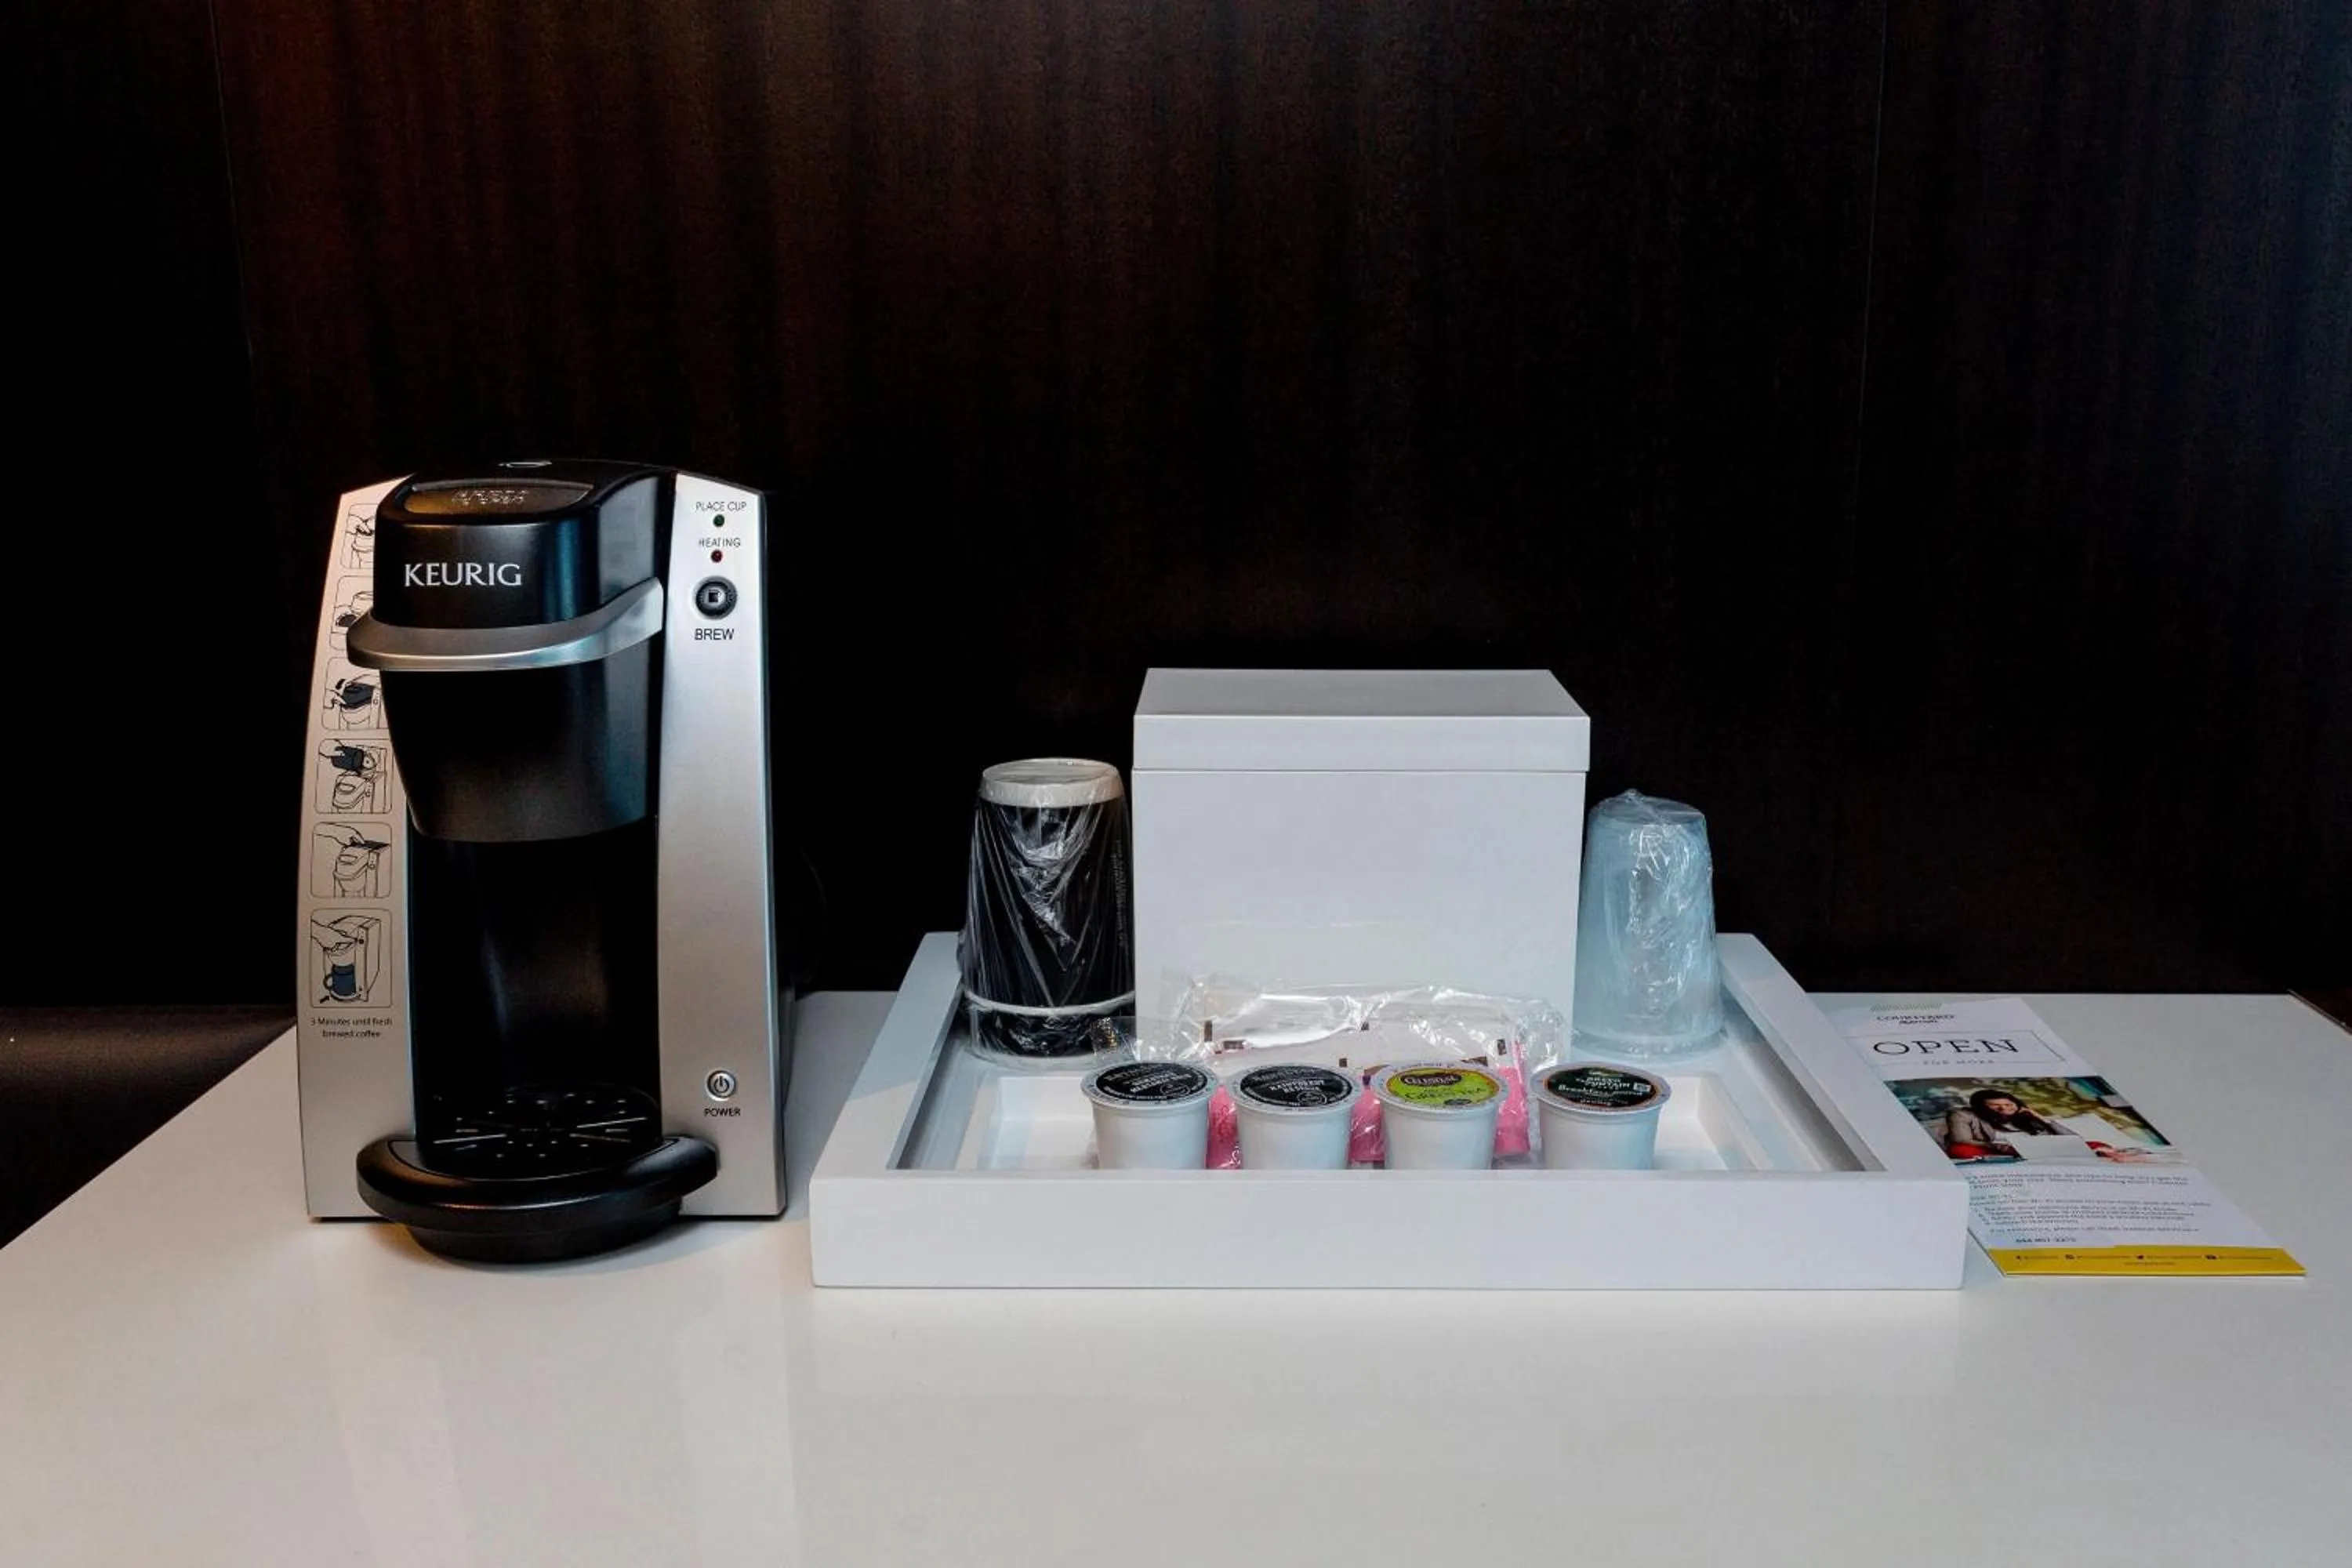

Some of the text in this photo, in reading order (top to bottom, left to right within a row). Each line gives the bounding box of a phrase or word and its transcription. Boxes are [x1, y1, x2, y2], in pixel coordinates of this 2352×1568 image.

[695, 501, 747, 511] PLACE CUP
[699, 537, 741, 548] HEATING
[405, 562, 522, 587] KEURIG
[695, 628, 735, 641] BREW
[318, 1017, 350, 1026] Minutes
[352, 1017, 371, 1026] until
[372, 1017, 393, 1026] fresh
[355, 1029, 382, 1038] coffee
[1873, 1039, 2020, 1056] OPEN
[703, 1107, 742, 1117] POWER
